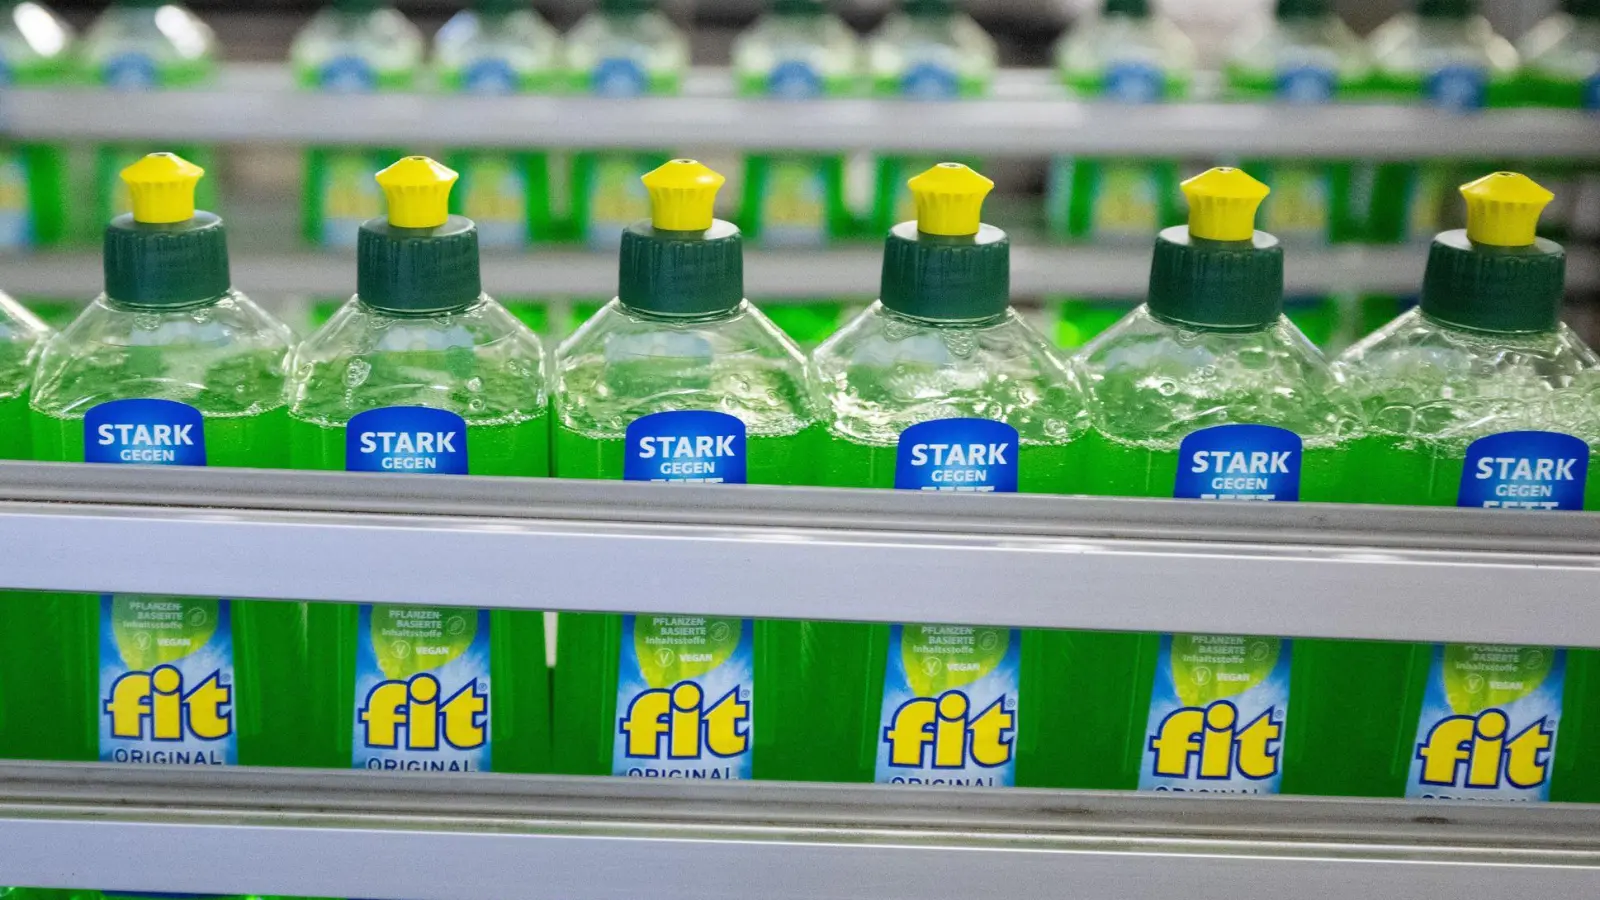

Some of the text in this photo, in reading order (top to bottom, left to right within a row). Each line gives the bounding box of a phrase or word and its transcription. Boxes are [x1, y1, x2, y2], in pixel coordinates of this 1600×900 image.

[98, 423, 194, 446] STARK
[360, 431, 456, 453] STARK
[639, 435, 736, 459] STARK
[120, 449, 174, 461] GEGEN
[911, 443, 1009, 466] STARK
[382, 457, 436, 469] GEGEN
[660, 461, 715, 474] GEGEN
[1191, 451, 1292, 473] STARK
[1475, 457, 1578, 480] STARK
[931, 470, 986, 482] GEGEN
[1211, 477, 1268, 490] GEGEN
[1495, 484, 1552, 497] GEGEN
[129, 602, 183, 611] PFLANZEN-
[138, 612, 183, 620] BASIERTE
[389, 610, 442, 620] PFLANZEN-
[122, 621, 183, 630] Inhaltsstoffe
[396, 620, 442, 629] BASIERTE
[653, 617, 706, 626] PFLANZEN-
[382, 628, 442, 638] Inhaltsstoffe
[661, 627, 706, 636] BASIERTE
[157, 638, 191, 647] VEGAN
[645, 636, 706, 645] Inhaltsstoffe
[928, 636, 975, 645] BASIERTE
[415, 646, 449, 655] VEGAN
[912, 645, 974, 654] Inhaltsstoffe
[1200, 646, 1246, 655] BASIERTE
[679, 653, 713, 662] VEGAN
[946, 663, 980, 671] VEGAN
[1216, 672, 1250, 681] VEGAN
[103, 664, 232, 742] fit
[357, 672, 488, 751] fit
[619, 680, 750, 760] fit
[883, 689, 1015, 769] fit
[1148, 699, 1283, 780] fit
[1415, 708, 1554, 789] fit
[114, 748, 222, 765] ORIGINAL
[368, 757, 475, 773] ORIGINAL
